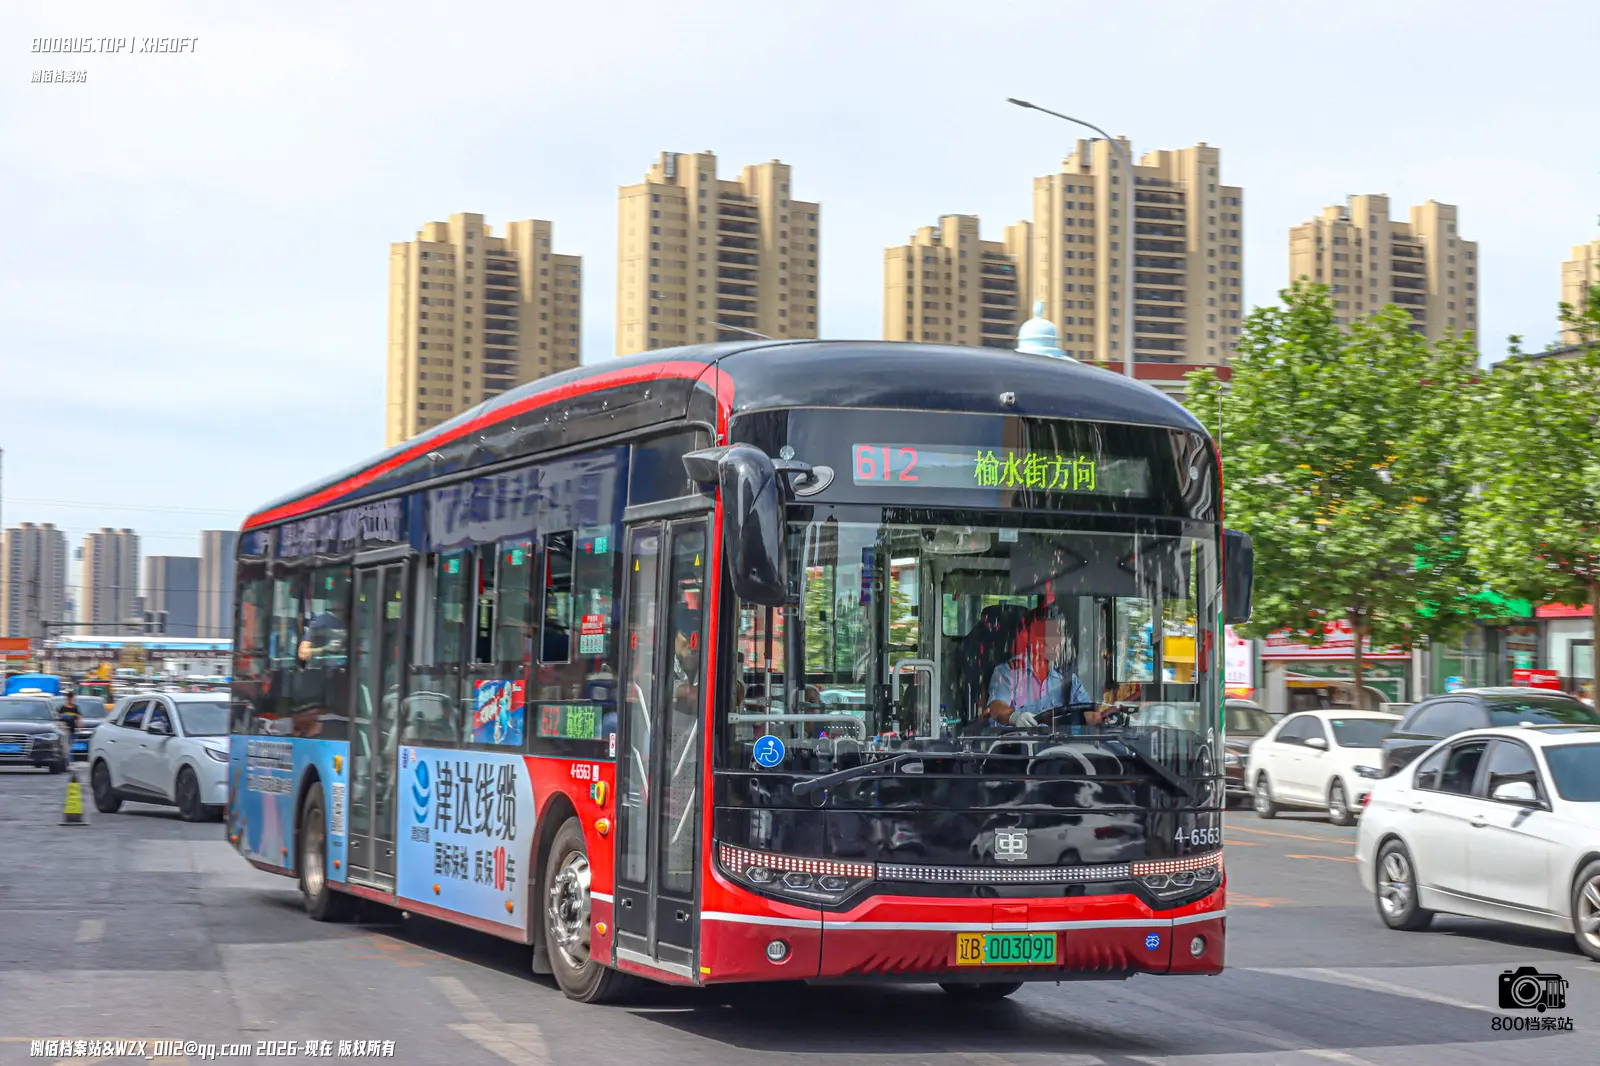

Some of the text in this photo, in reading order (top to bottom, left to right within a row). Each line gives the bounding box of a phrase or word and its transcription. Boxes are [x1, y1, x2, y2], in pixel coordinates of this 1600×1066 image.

[856, 445, 1096, 491] 612 榆水街方向
[541, 705, 561, 736] 612
[570, 763, 591, 780] 4-6563
[434, 760, 517, 841] 津达线缆
[1174, 826, 1220, 846] 4-6563
